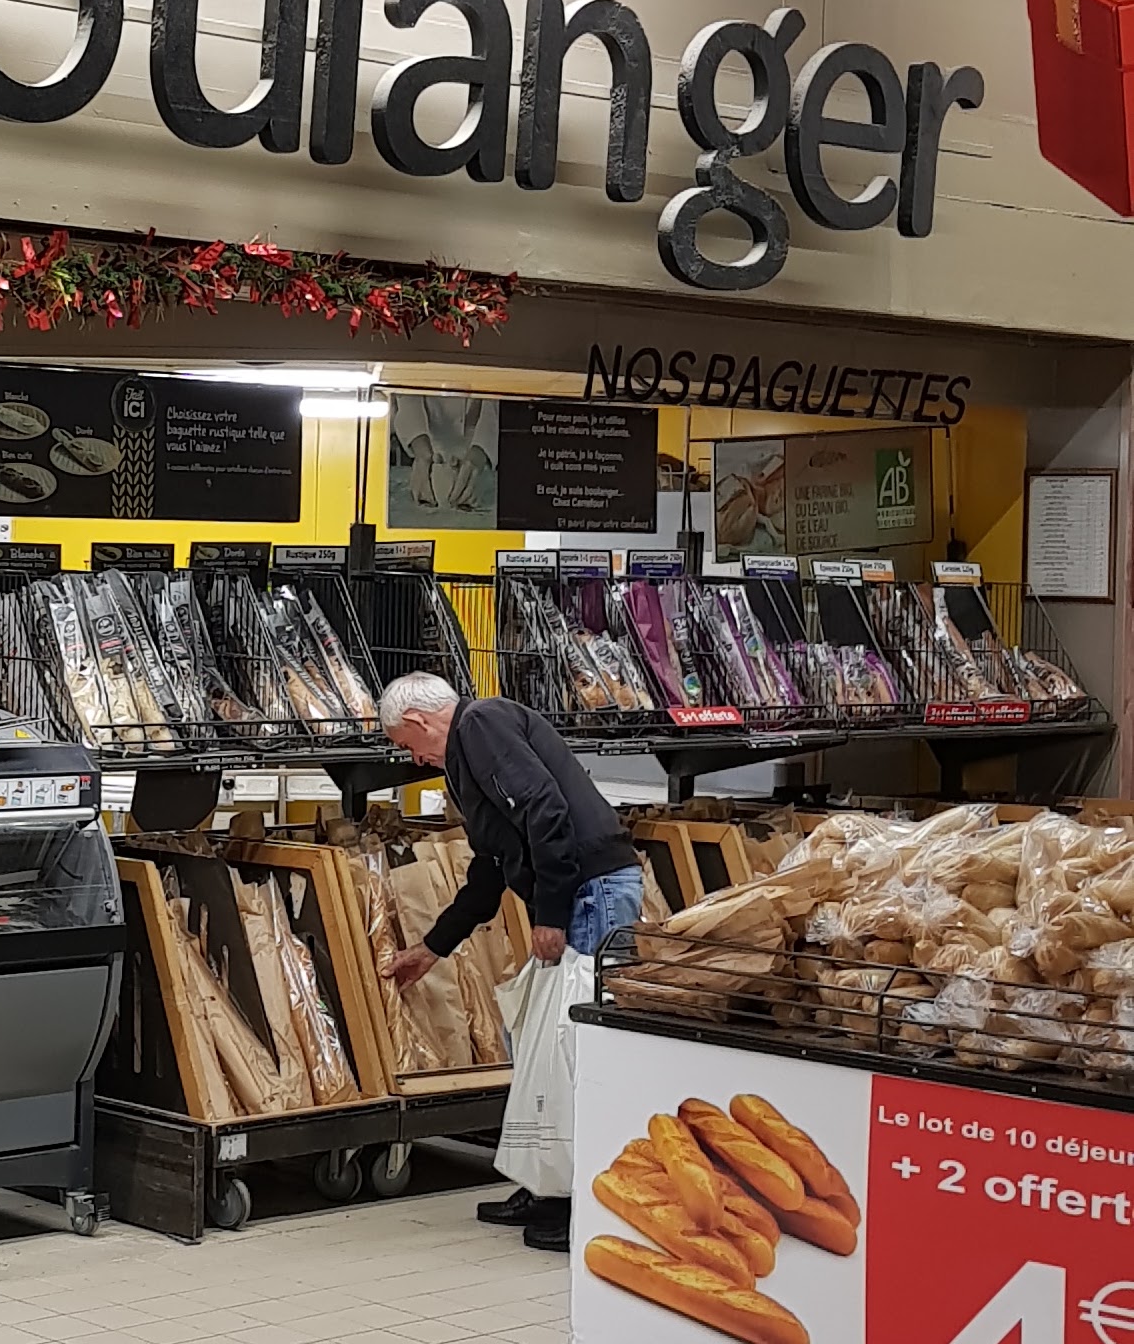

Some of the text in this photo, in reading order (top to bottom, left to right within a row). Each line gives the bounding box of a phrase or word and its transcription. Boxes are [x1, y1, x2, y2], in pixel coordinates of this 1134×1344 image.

[584, 344, 970, 425] NOS BAGUETTES
[124, 401, 145, 418] ICI
[167, 407, 238, 422] Choisissez votre
[538, 412, 626, 426] Pour mon pain, je n'utilise
[167, 424, 285, 443] baguette rustique telle que
[532, 424, 631, 439] que les meilleurs ingrédients.
[167, 441, 186, 453] vous
[190, 440, 220, 454] l'aimez
[538, 448, 547, 458] Je
[556, 449, 578, 461] pétris,
[579, 451, 586, 461] je
[595, 450, 624, 463] façonne,
[551, 462, 564, 471] cuit
[565, 463, 582, 471] sous
[584, 464, 598, 472] mes
[600, 465, 617, 474] yeux.
[537, 485, 545, 495] Et
[546, 485, 559, 496] oui,
[560, 486, 568, 497] je
[569, 486, 583, 495] suis
[794, 486, 810, 500] UNE
[811, 485, 838, 499] FARINE
[879, 466, 910, 507] AB
[552, 498, 571, 507] Chez
[572, 498, 605, 509] Carrefour
[795, 503, 807, 517] DU
[808, 502, 834, 516] LEVAIN
[558, 518, 566, 528] Et
[796, 520, 807, 534] DE
[796, 534, 838, 550] DE SOURCE
[10, 549, 44, 560] Blanche
[286, 549, 336, 561] Rustique 250g
[506, 554, 548, 564] Rustique 125g
[632, 553, 668, 564] Campagnarde
[747, 558, 782, 570] Campagnarde
[678, 709, 737, 723] 3+1 offerte
[878, 1105, 910, 1127] Le
[918, 1111, 954, 1135] lot
[962, 1121, 995, 1142] de
[1005, 1127, 1038, 1149] 10
[891, 1156, 1134, 1226] + 2 offert
